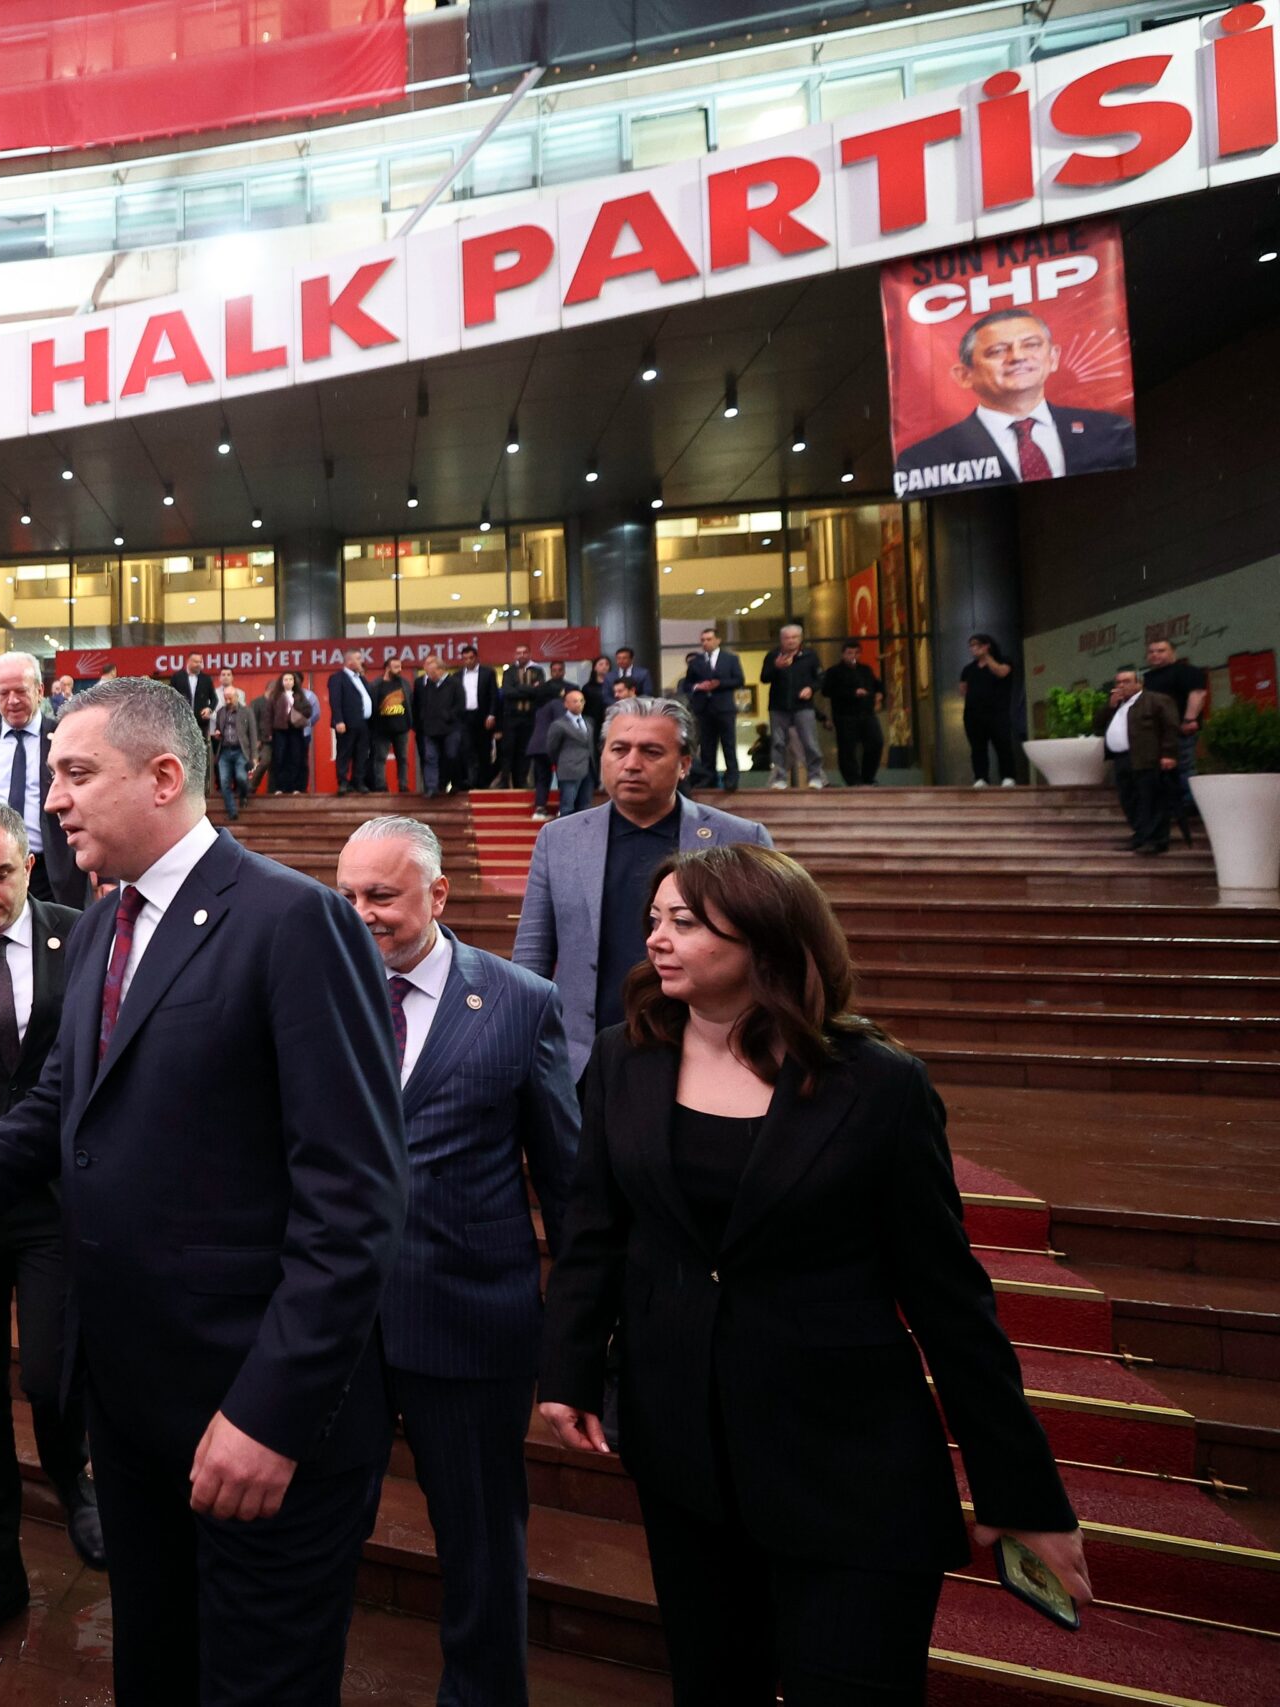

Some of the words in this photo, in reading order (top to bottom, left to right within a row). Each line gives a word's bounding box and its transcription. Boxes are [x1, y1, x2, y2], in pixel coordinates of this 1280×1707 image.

[31, 257, 400, 416] HALK
[462, 3, 1279, 329] PARTİSİ
[912, 246, 982, 285] SON
[996, 226, 1088, 267] KALE
[907, 255, 1099, 324] CHP
[893, 456, 1002, 498] ÇANKAYA
[155, 647, 303, 671] CUHURİYET
[311, 647, 375, 665] HAK
